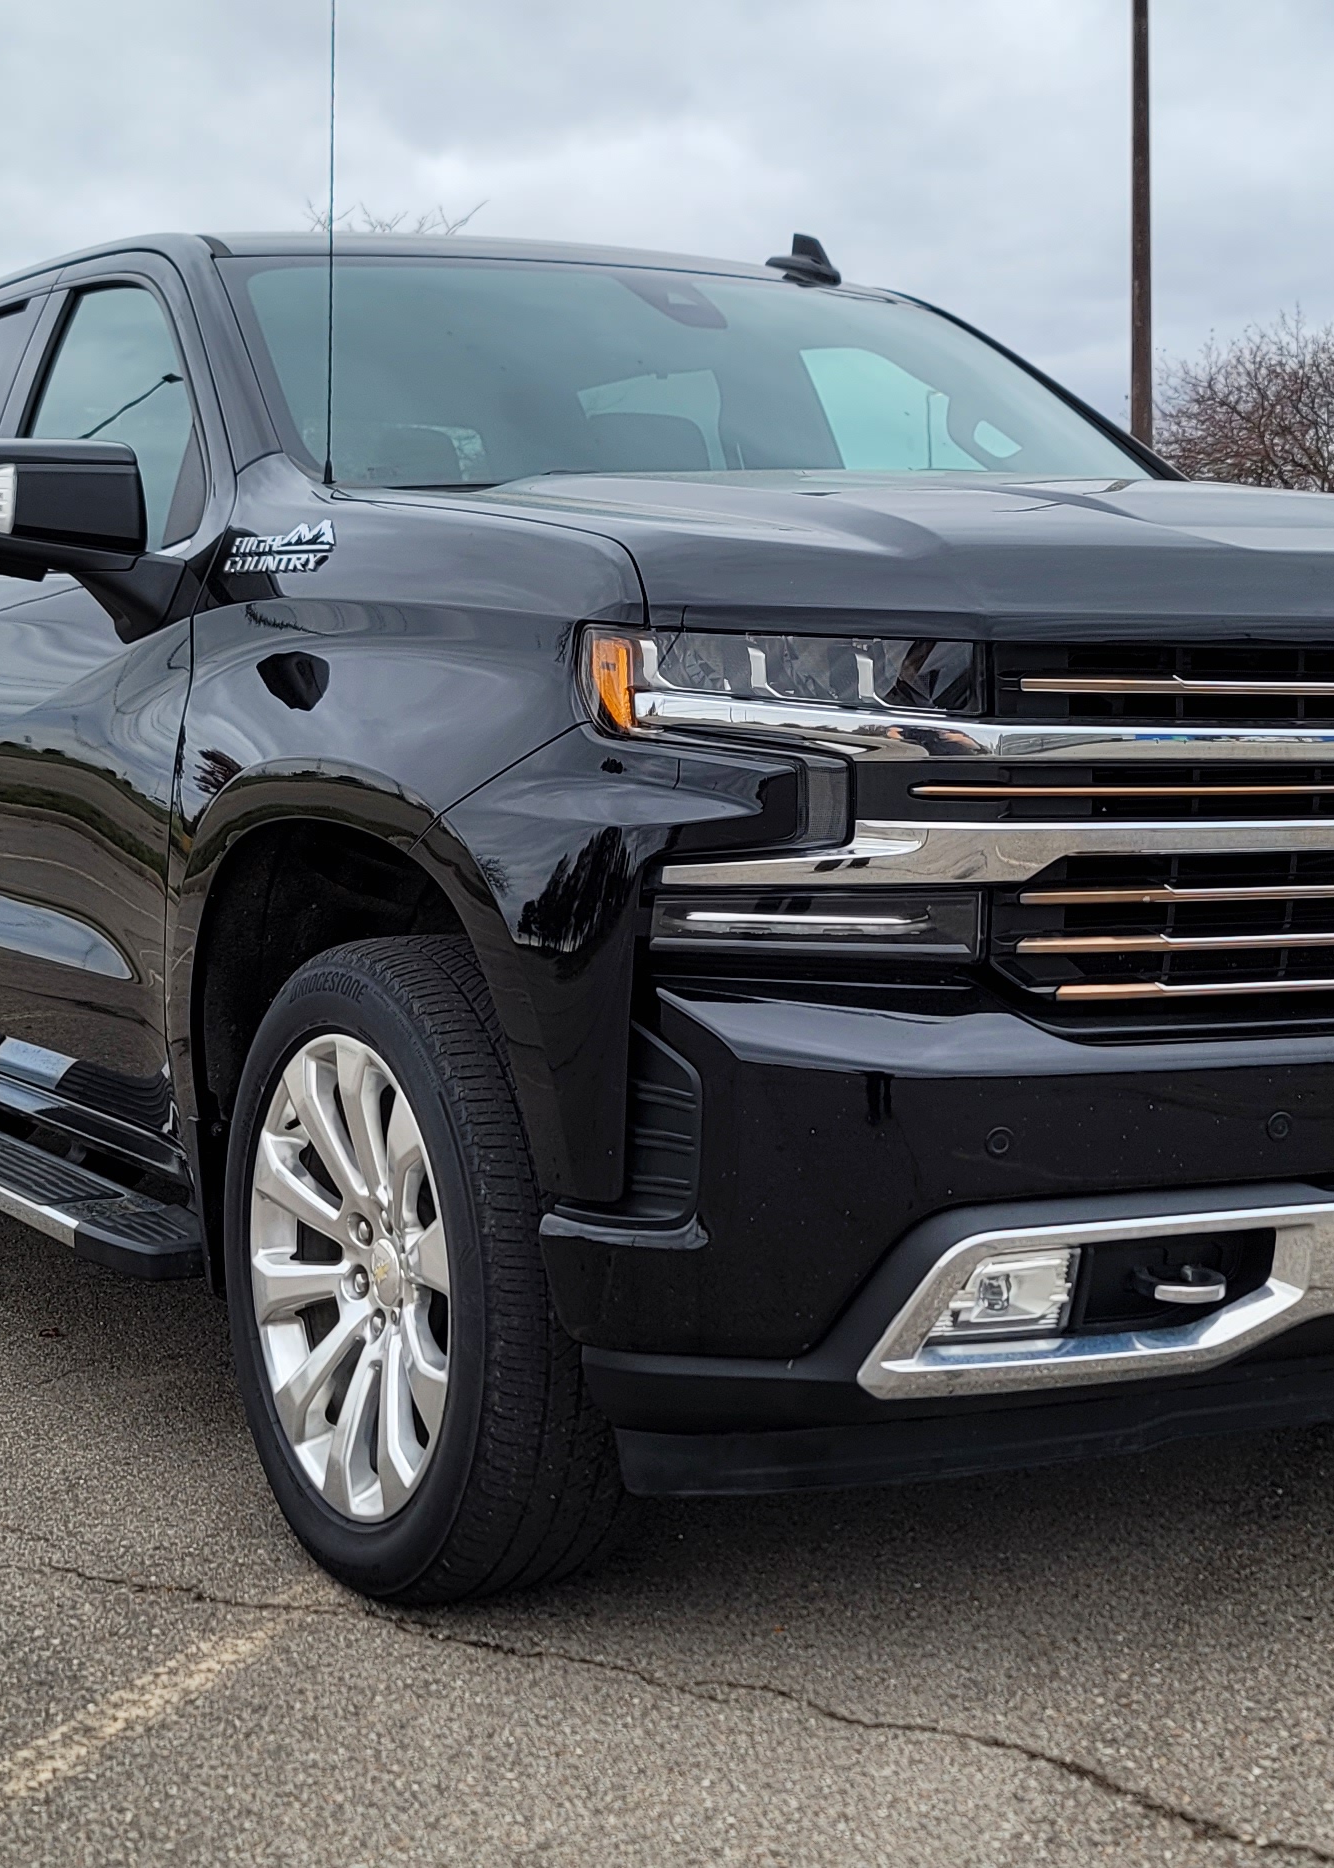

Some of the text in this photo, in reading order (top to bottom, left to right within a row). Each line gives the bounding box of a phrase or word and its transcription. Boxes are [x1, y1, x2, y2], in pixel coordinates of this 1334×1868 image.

[231, 535, 284, 554] HIGH
[224, 553, 328, 573] COUNTRY
[289, 970, 368, 1005] BRIDGESTONE
